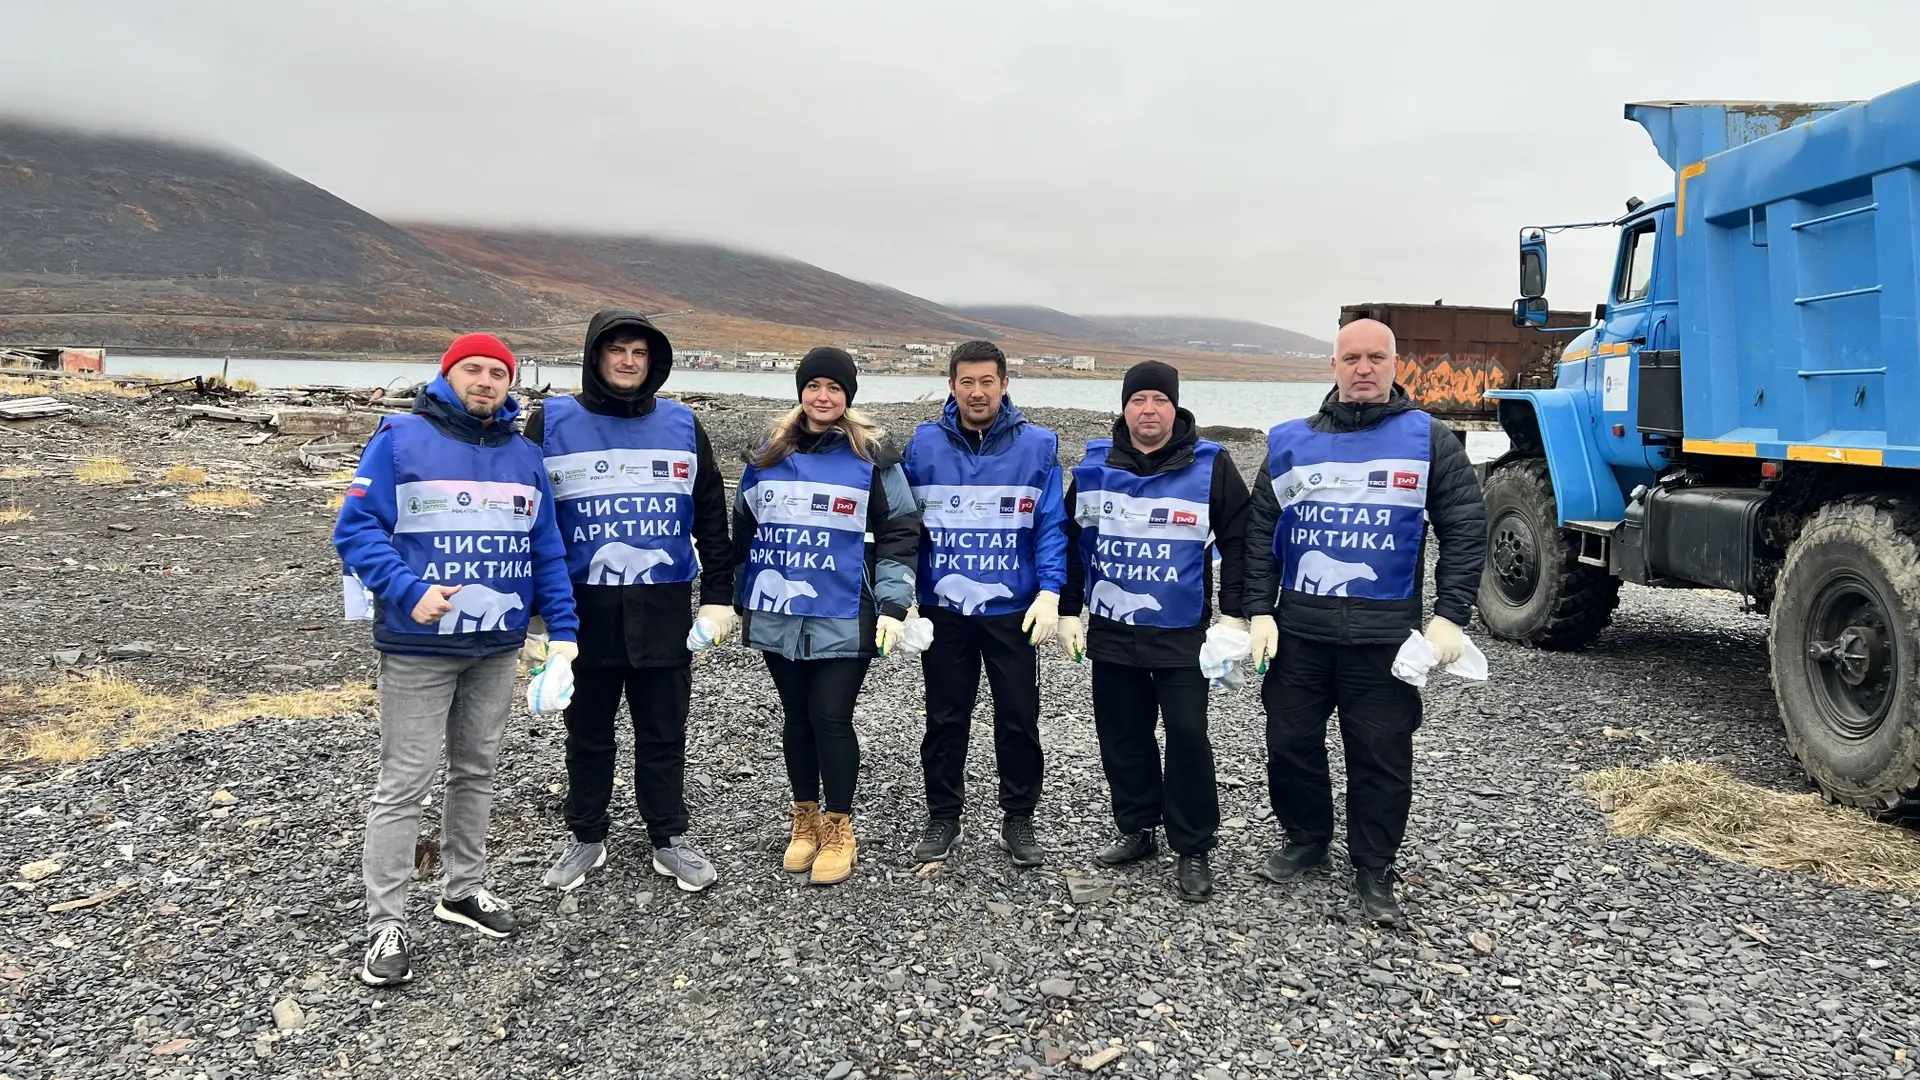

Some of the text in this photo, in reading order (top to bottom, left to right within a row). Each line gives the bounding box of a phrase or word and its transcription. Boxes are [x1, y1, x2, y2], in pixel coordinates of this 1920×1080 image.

[577, 497, 677, 517] ЧИСТАЯ
[573, 520, 681, 542] АРКТИКА
[929, 531, 1018, 549] ЧИСТАЯ
[433, 535, 531, 554] ЧИСТАЯ
[1096, 535, 1172, 560] ИСТАЯ
[422, 560, 532, 581] АРКТИКА
[1091, 553, 1179, 583] АКТИКА
